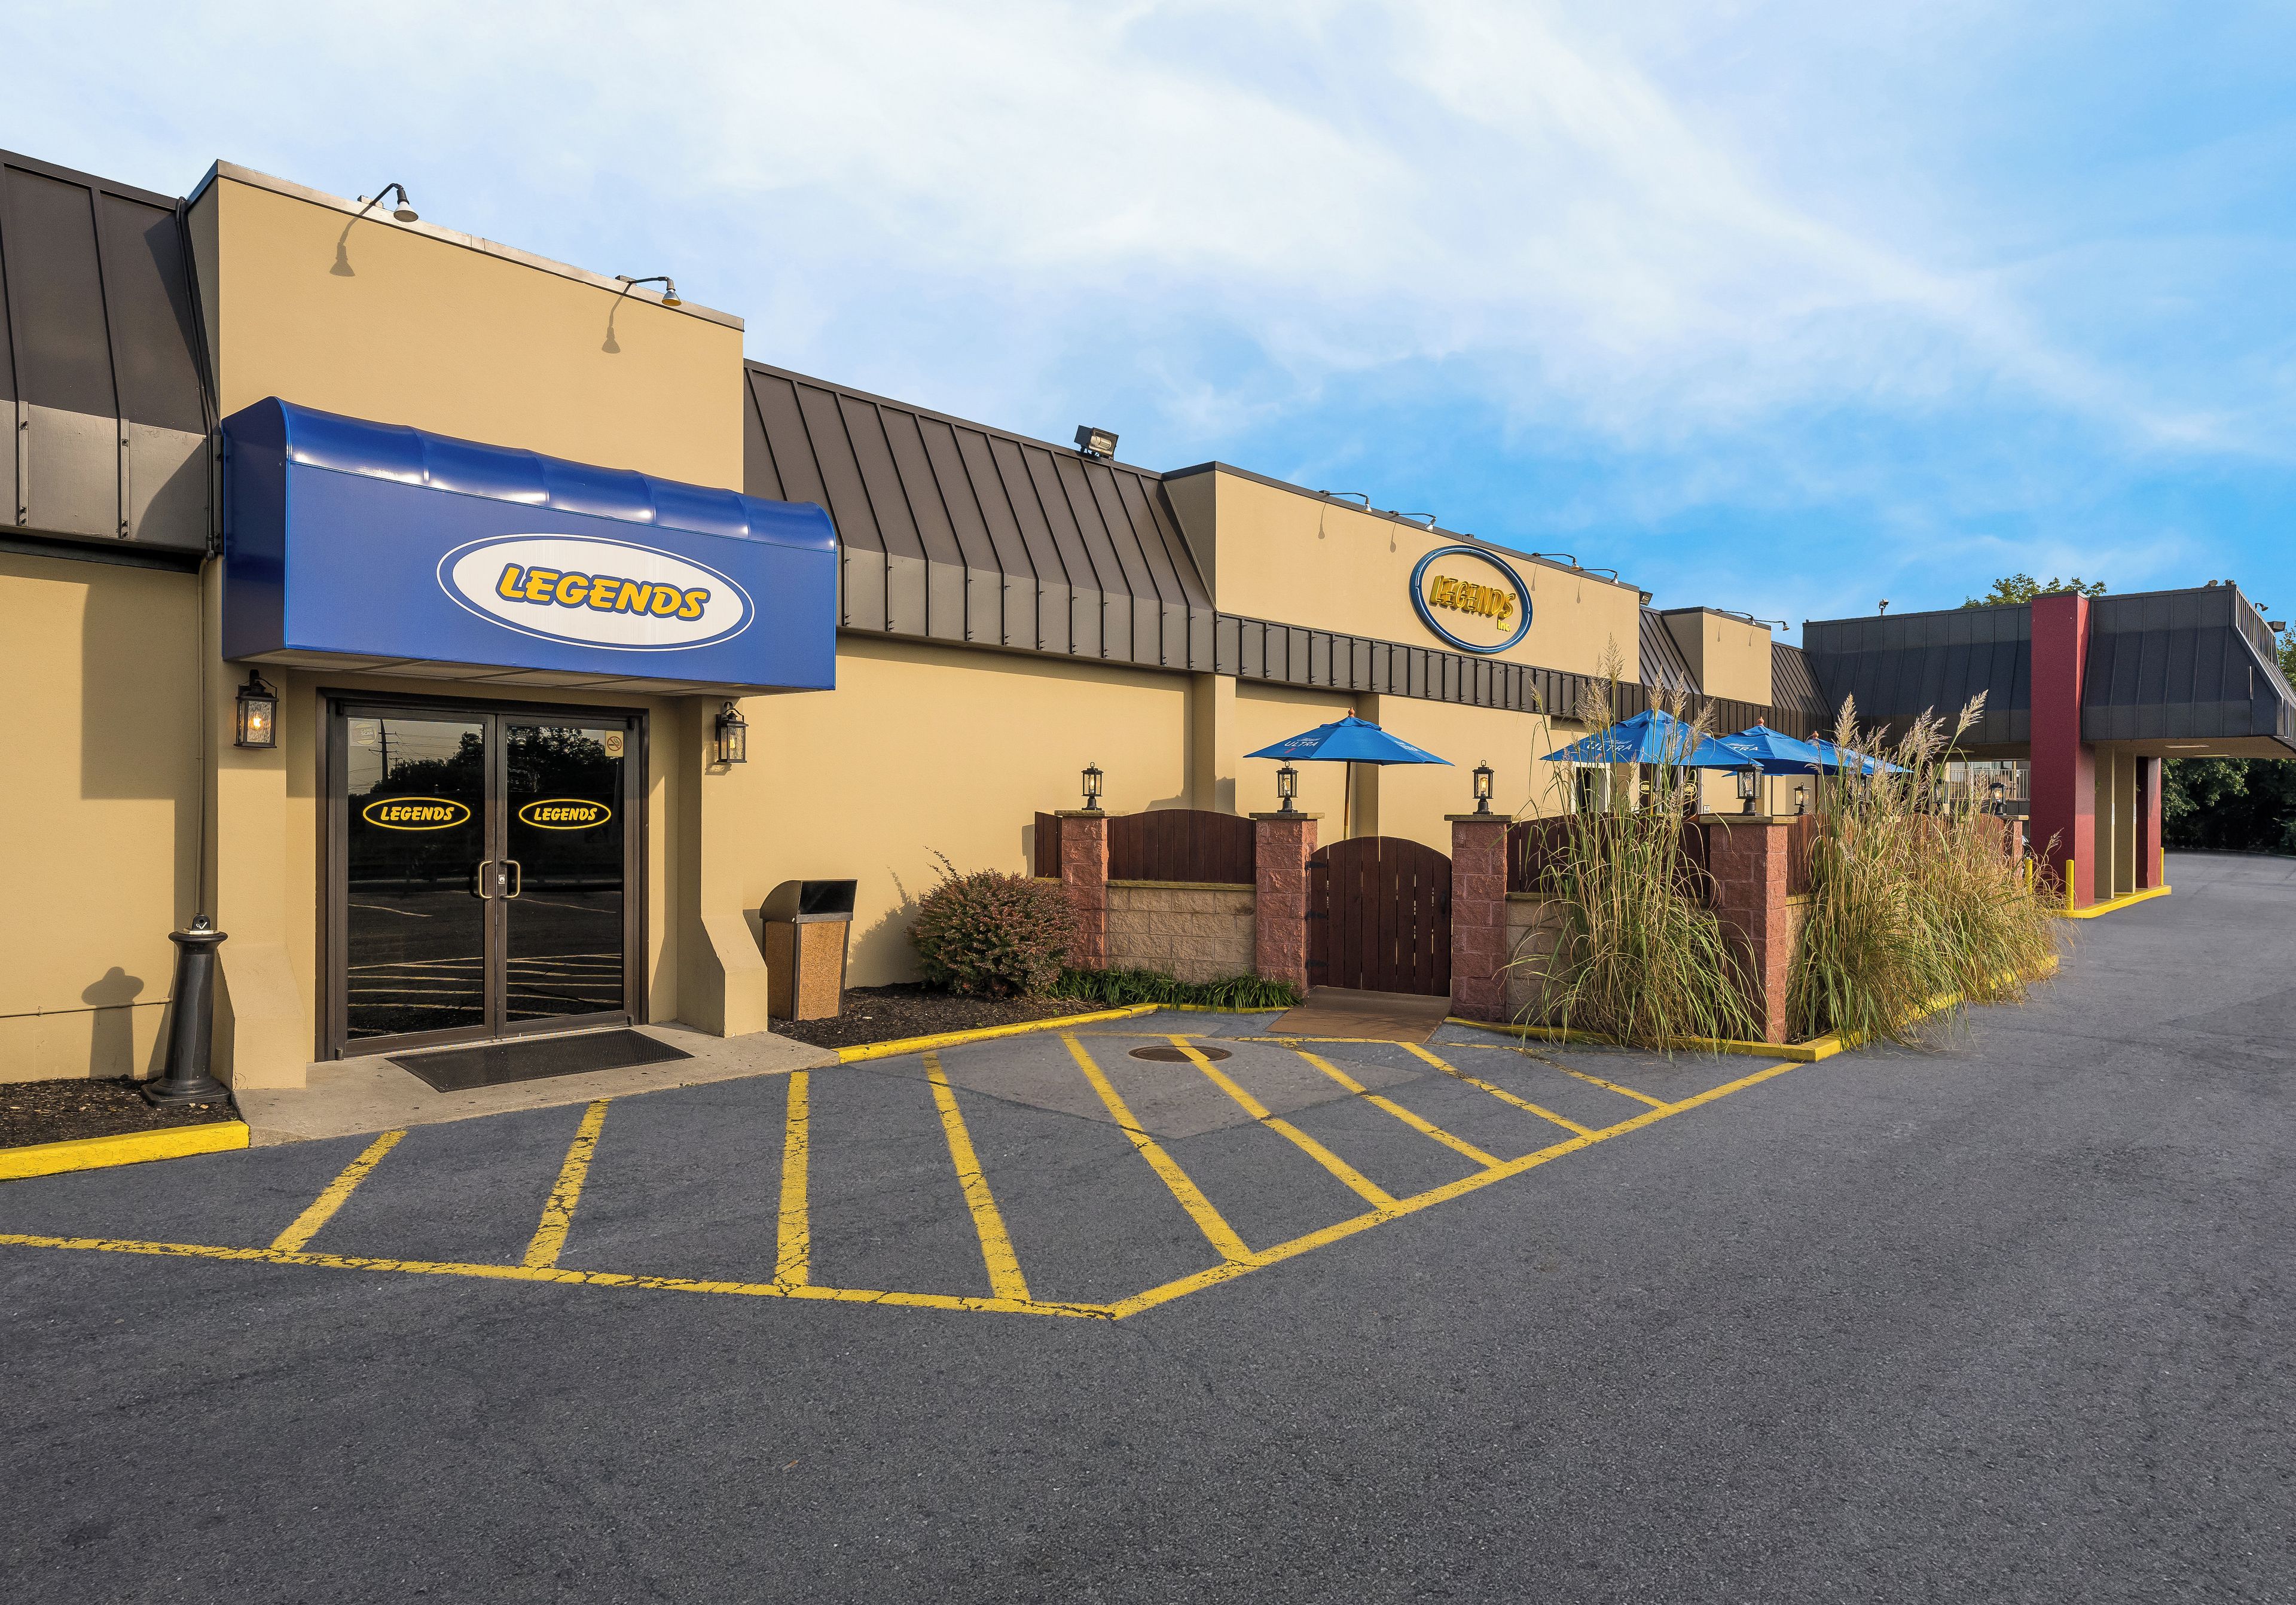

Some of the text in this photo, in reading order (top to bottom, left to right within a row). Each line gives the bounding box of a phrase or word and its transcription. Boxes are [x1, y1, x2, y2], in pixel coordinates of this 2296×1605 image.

[499, 566, 708, 619] LEGENDS
[1430, 575, 1516, 618] LEGENDS
[1497, 619, 1512, 631] inc.
[380, 806, 454, 820] LEGENDS
[534, 807, 597, 820] LEGENDS
